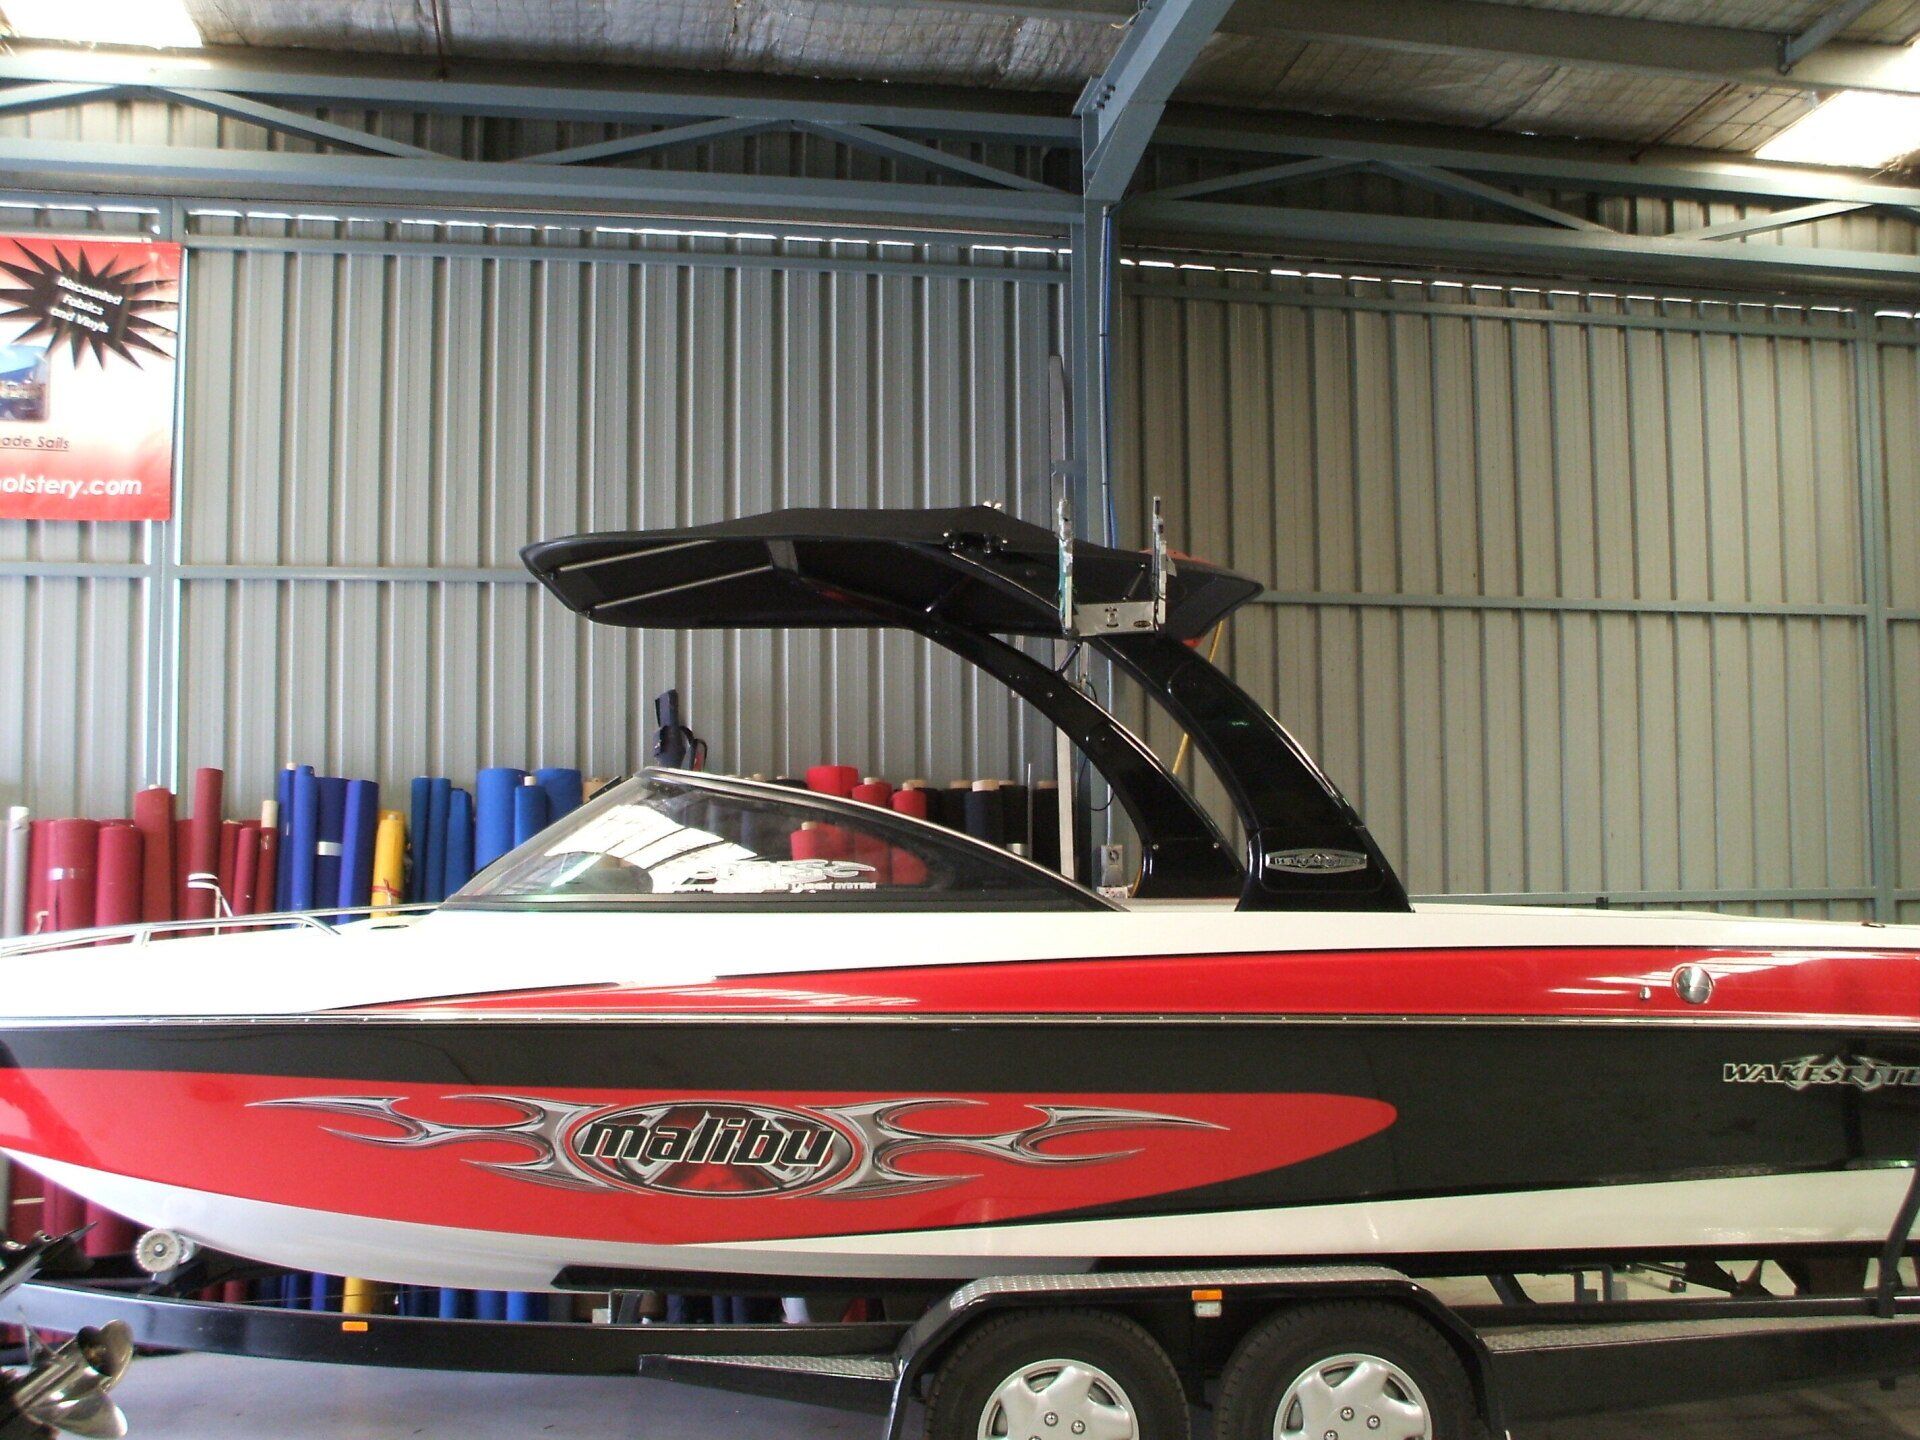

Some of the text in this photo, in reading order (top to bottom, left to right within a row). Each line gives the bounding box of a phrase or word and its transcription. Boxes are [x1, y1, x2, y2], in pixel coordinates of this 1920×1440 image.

[57, 276, 123, 305] Discounted
[50, 306, 76, 322] and
[62, 294, 105, 316] Fabrics
[36, 435, 70, 449] Sails
[0, 473, 142, 500] olstery.com
[579, 1116, 835, 1167] malibu
